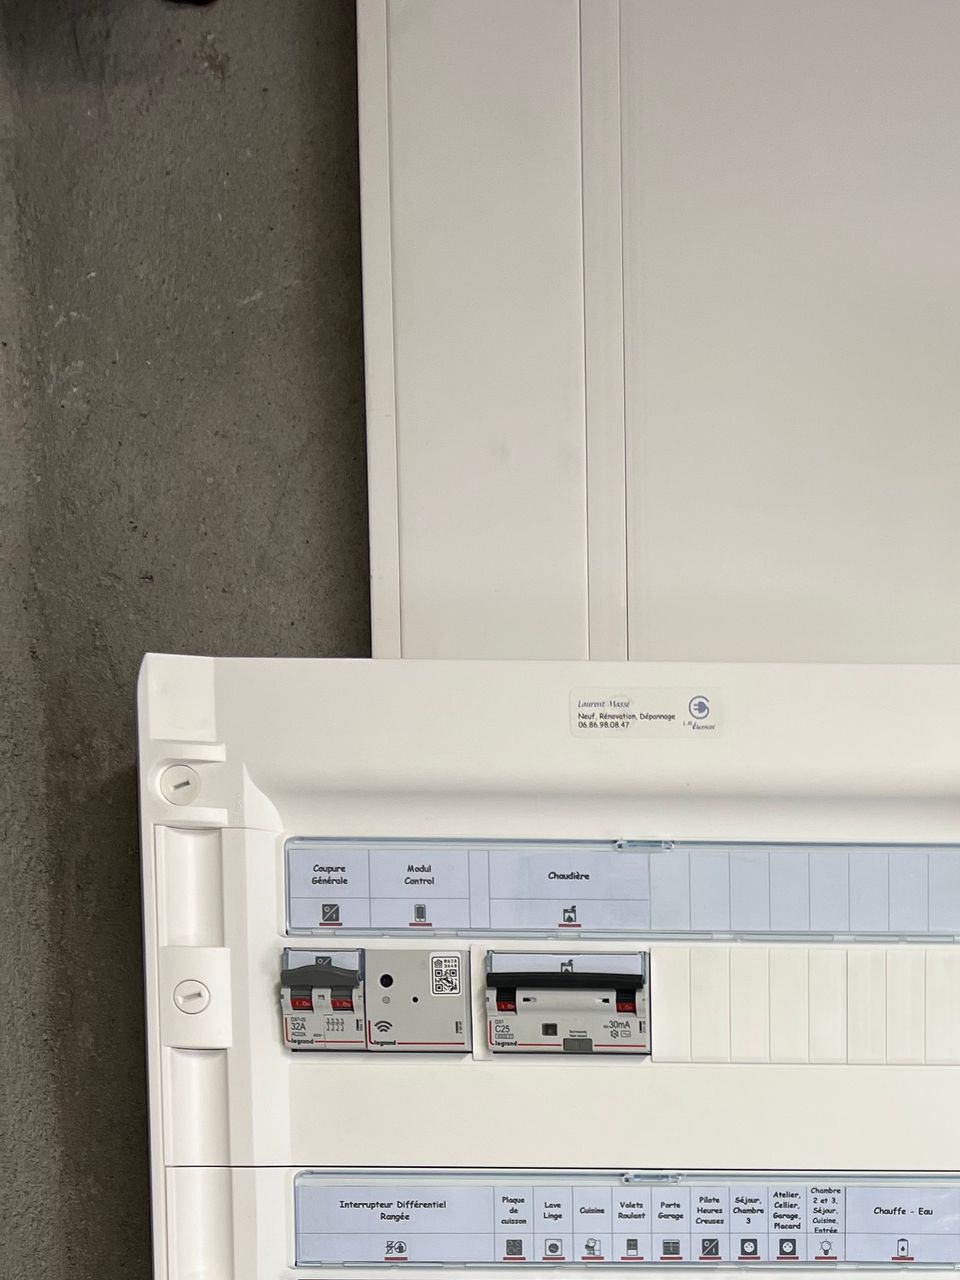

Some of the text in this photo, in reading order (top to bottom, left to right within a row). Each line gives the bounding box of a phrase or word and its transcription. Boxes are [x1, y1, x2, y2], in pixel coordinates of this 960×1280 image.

[578, 700, 605, 708] Laurent
[640, 713, 675, 721] Dépannage
[313, 864, 345, 874] Coupure
[312, 876, 348, 884] Générale
[548, 872, 589, 880] Chaudière
[291, 1023, 306, 1031] 32A
[609, 1020, 631, 1029] 30mA
[735, 1196, 761, 1205] Séjour,
[340, 1201, 393, 1210] Interrupteur
[813, 1207, 838, 1215] Séjour,
[874, 1207, 906, 1215] Chauffe
[381, 1212, 409, 1222] Rangée
[544, 1212, 562, 1221] Linge
[658, 1212, 683, 1220] Garage
[773, 1212, 801, 1220] Garage,
